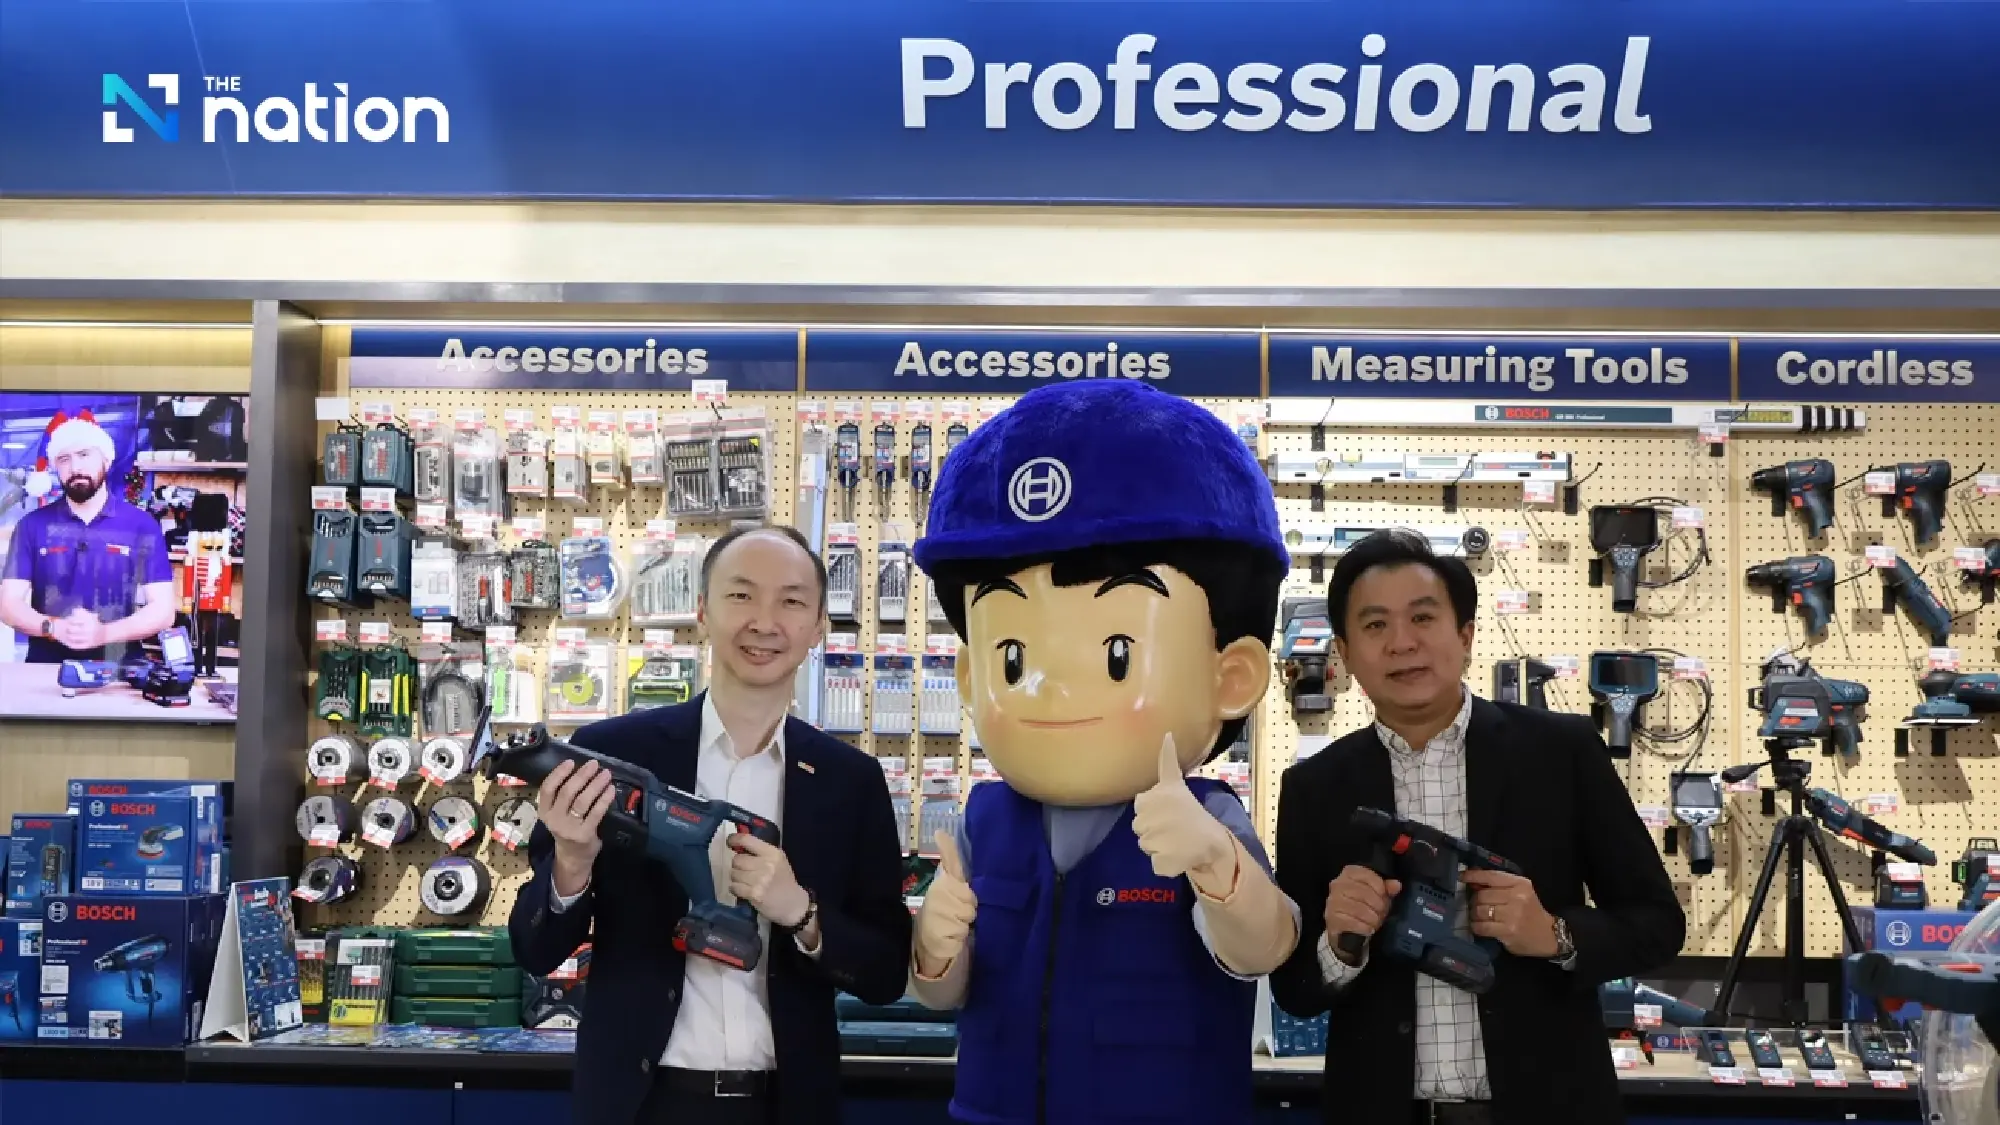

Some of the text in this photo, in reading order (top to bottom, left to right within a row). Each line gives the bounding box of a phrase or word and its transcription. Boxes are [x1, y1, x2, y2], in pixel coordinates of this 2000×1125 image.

[901, 33, 1652, 133] Professional
[437, 338, 709, 374] Accessories
[894, 341, 1171, 379] Accessories
[1311, 345, 1689, 391] Measuring Tools
[1776, 349, 1974, 386] Cordless
[1504, 407, 1549, 418] BOSCH
[88, 785, 128, 795] BOSCH
[111, 803, 156, 815] BOSCH
[1117, 887, 1175, 903] BOSCH
[76, 905, 136, 921] BOSCH
